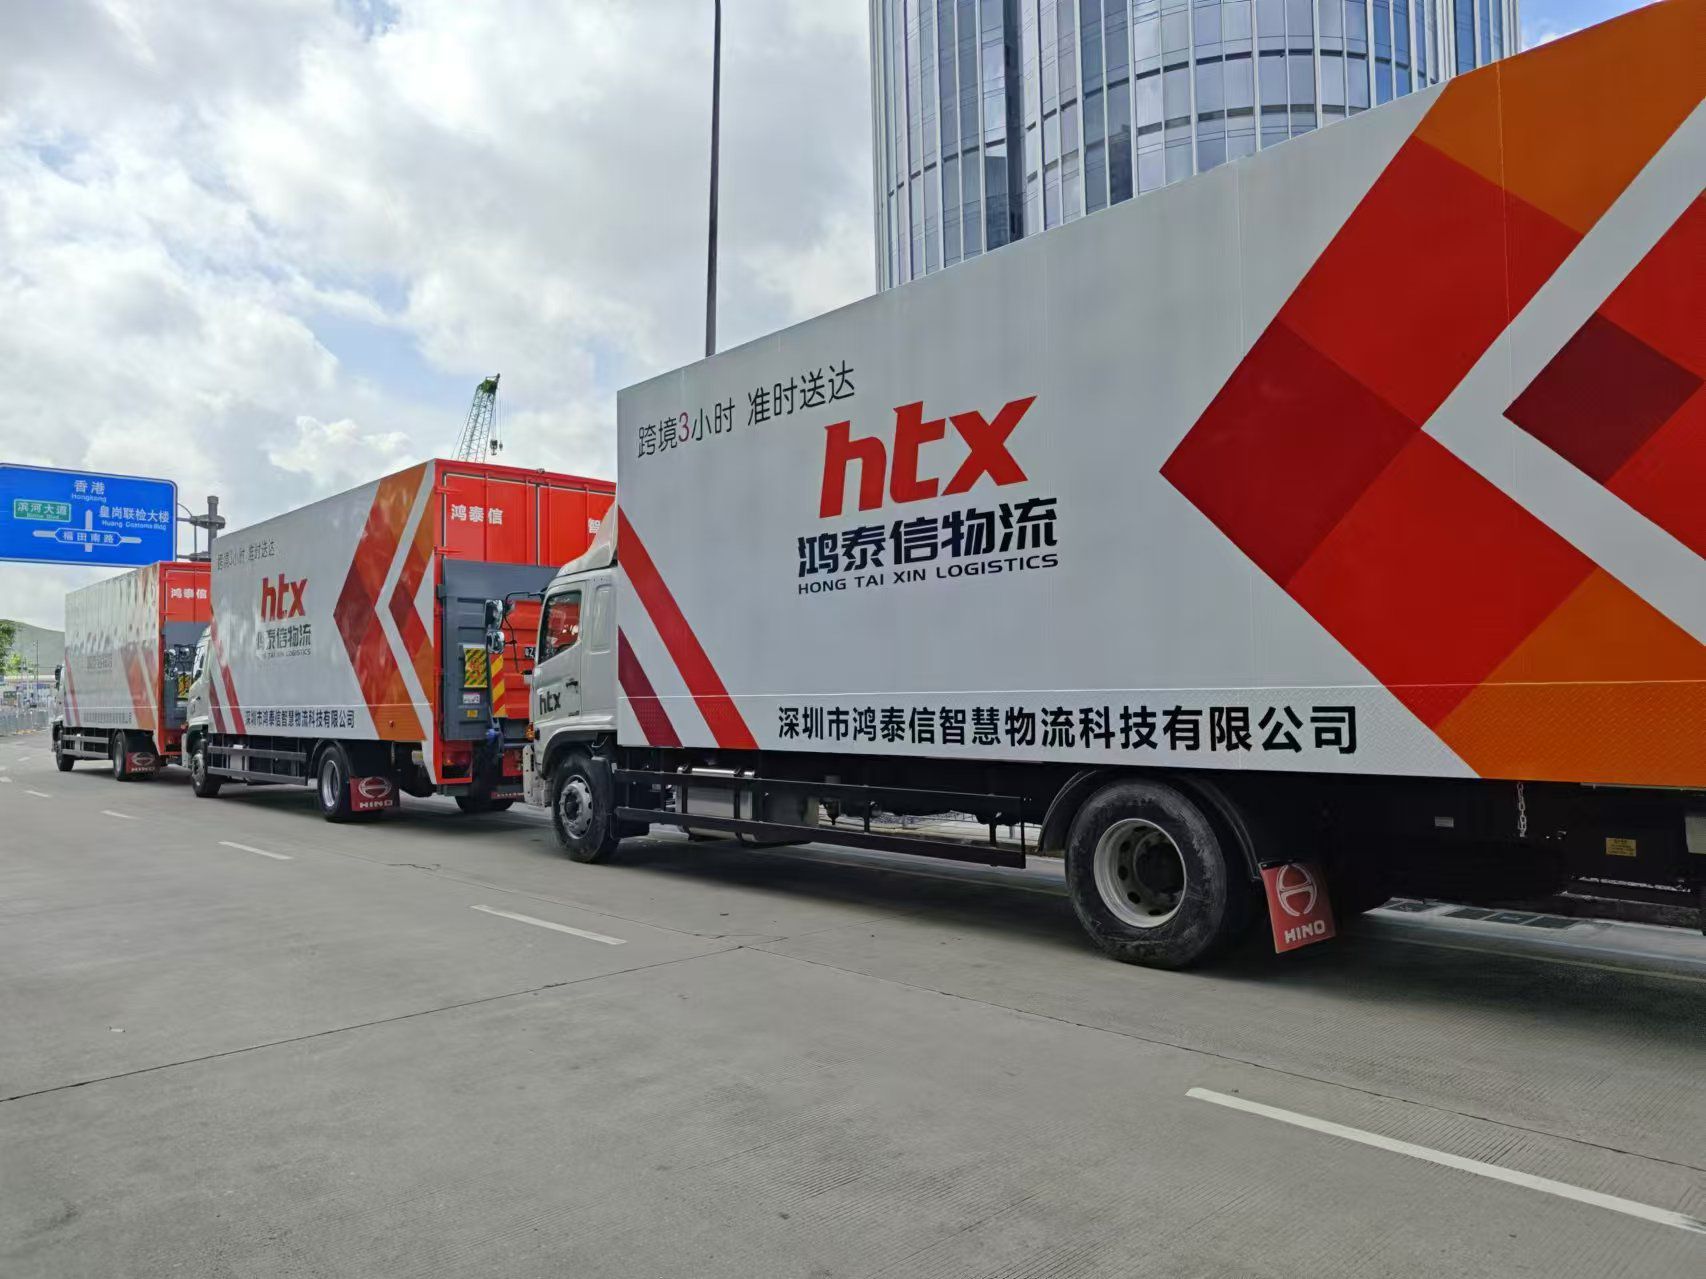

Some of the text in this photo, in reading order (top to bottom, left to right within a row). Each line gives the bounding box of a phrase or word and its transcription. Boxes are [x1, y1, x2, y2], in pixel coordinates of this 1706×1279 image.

[638, 360, 855, 458] 跨境3小时 准时送达
[819, 396, 1037, 518] htx
[74, 480, 105, 495] 香港
[17, 502, 68, 516] 滨河大道
[99, 505, 170, 523] 皇岗联检大楼
[451, 504, 503, 525] 鸿泰信
[63, 531, 114, 544] 福田南路
[798, 498, 1058, 578] 鸿泰信物流
[798, 553, 1058, 595] HONG TAI XIN LOGISTICS
[261, 573, 308, 622] htx
[539, 691, 561, 715] htx
[777, 705, 1359, 755] 深圳市鸿泰信智慧物流科技有限公司
[359, 800, 393, 809] HINO
[1284, 919, 1327, 944] HINO
